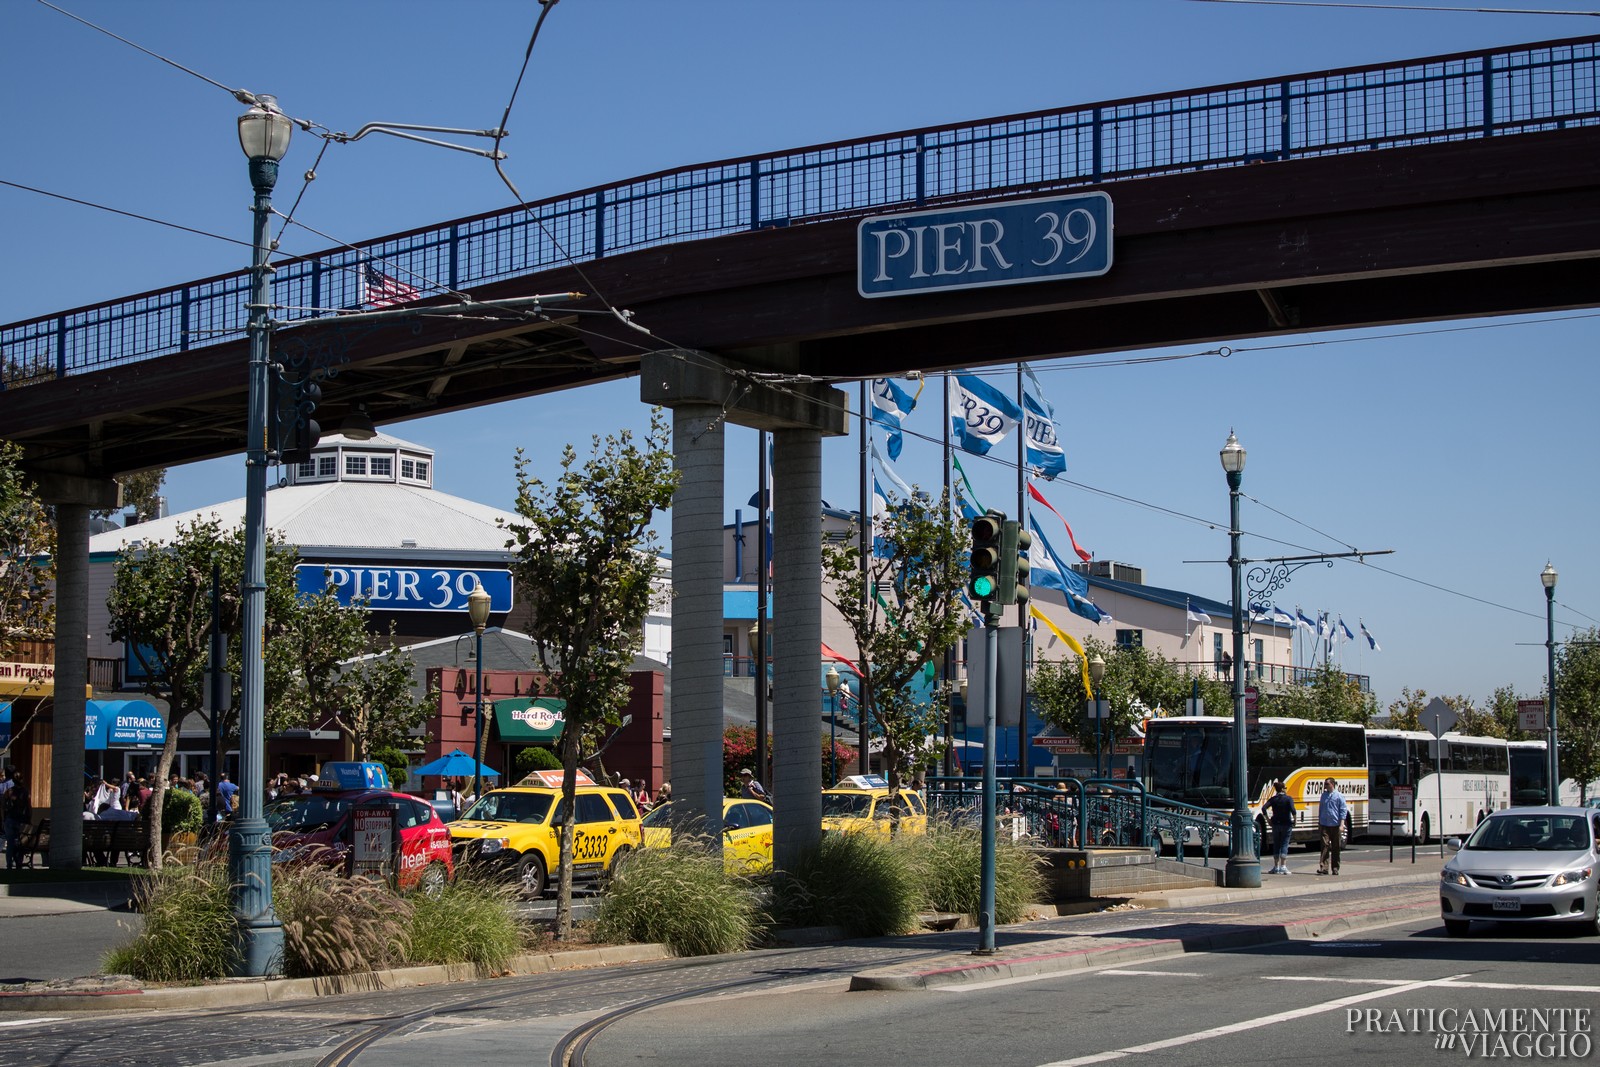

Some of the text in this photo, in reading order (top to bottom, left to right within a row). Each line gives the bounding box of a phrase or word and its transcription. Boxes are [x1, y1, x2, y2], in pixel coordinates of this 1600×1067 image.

[870, 208, 1097, 283] PIER 39
[966, 408, 1004, 436] 39
[328, 568, 481, 610] PIER 39
[455, 674, 492, 690] ALL
[116, 716, 162, 728] ENTRANCE
[512, 710, 565, 722] Hard Rock
[1335, 781, 1366, 796] oachways
[354, 818, 391, 830] NO STOPPING
[365, 832, 381, 842] ANY
[364, 843, 382, 853] TIME
[572, 834, 608, 859] 3-3333
